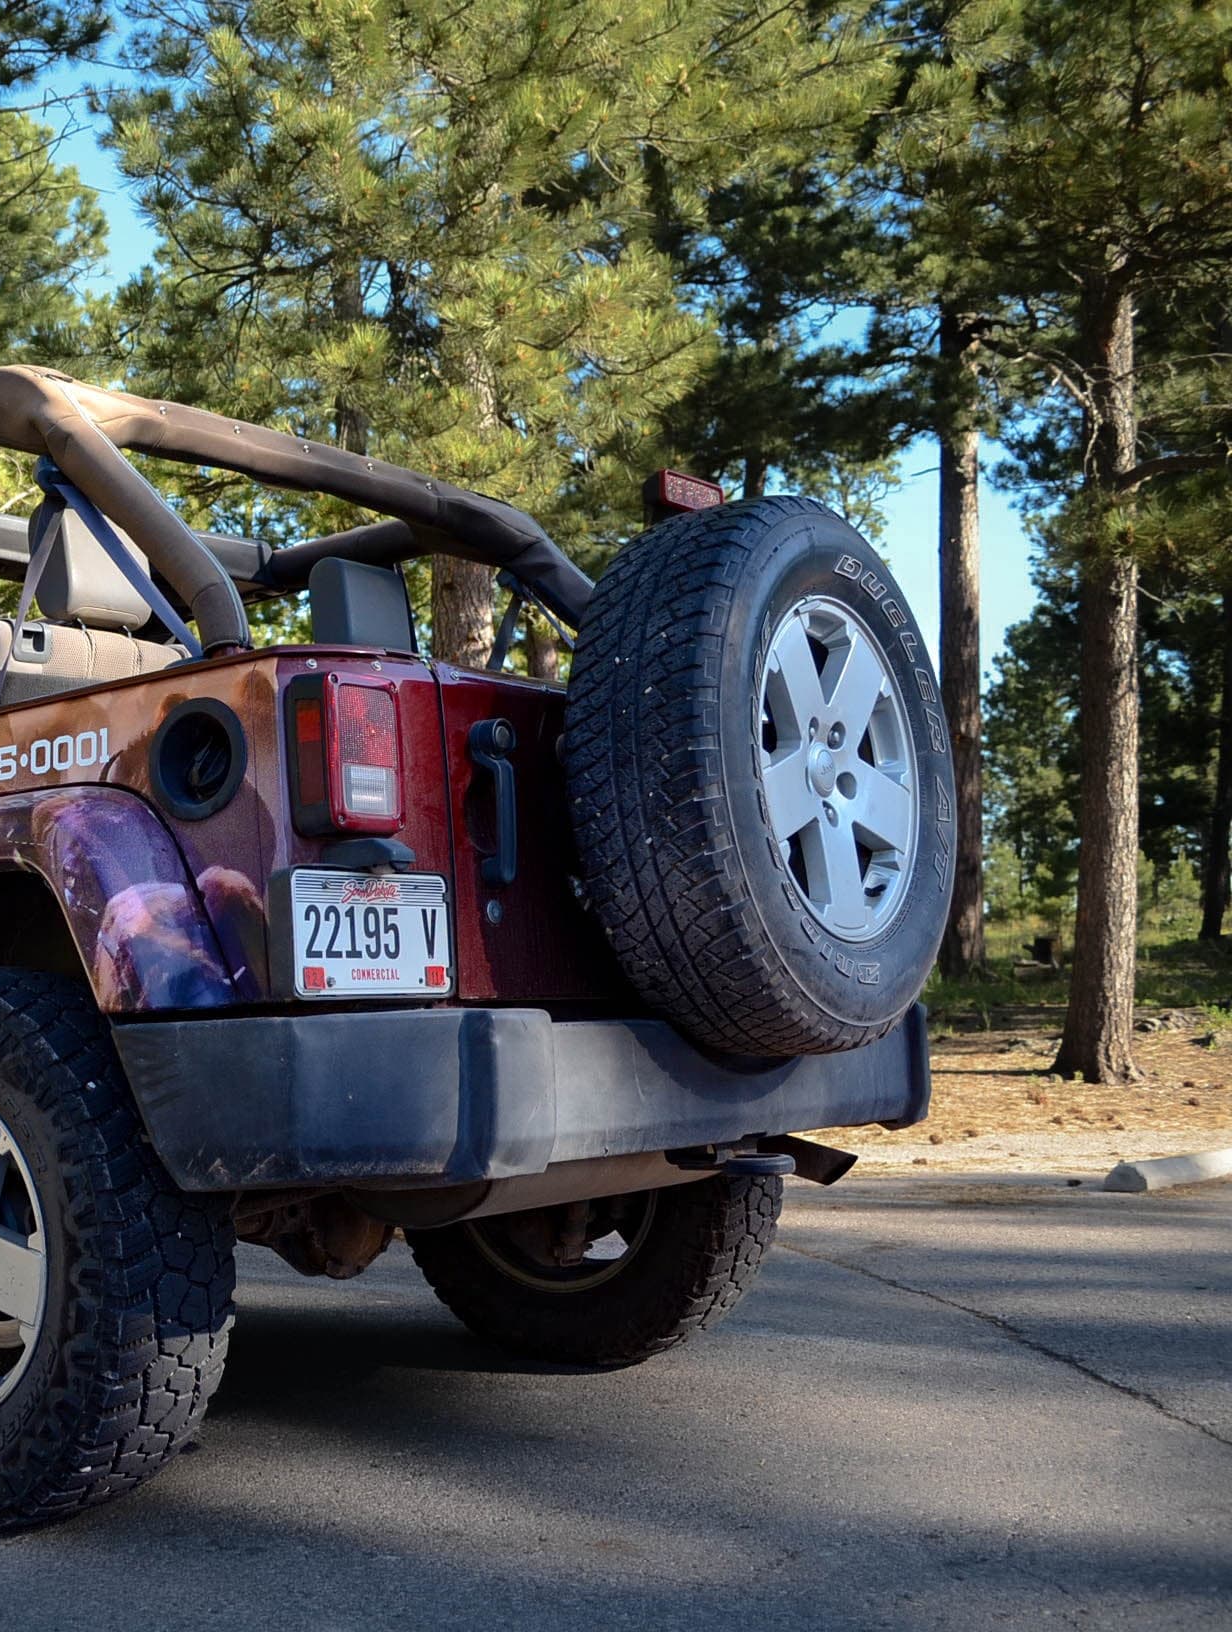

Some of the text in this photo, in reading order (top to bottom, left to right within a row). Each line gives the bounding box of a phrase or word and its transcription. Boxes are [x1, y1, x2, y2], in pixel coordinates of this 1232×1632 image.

[834, 554, 946, 754] DUELER
[934, 775, 955, 892] A/T
[304, 904, 437, 960] 22195 V
[351, 968, 400, 981] COMMERCIAL
